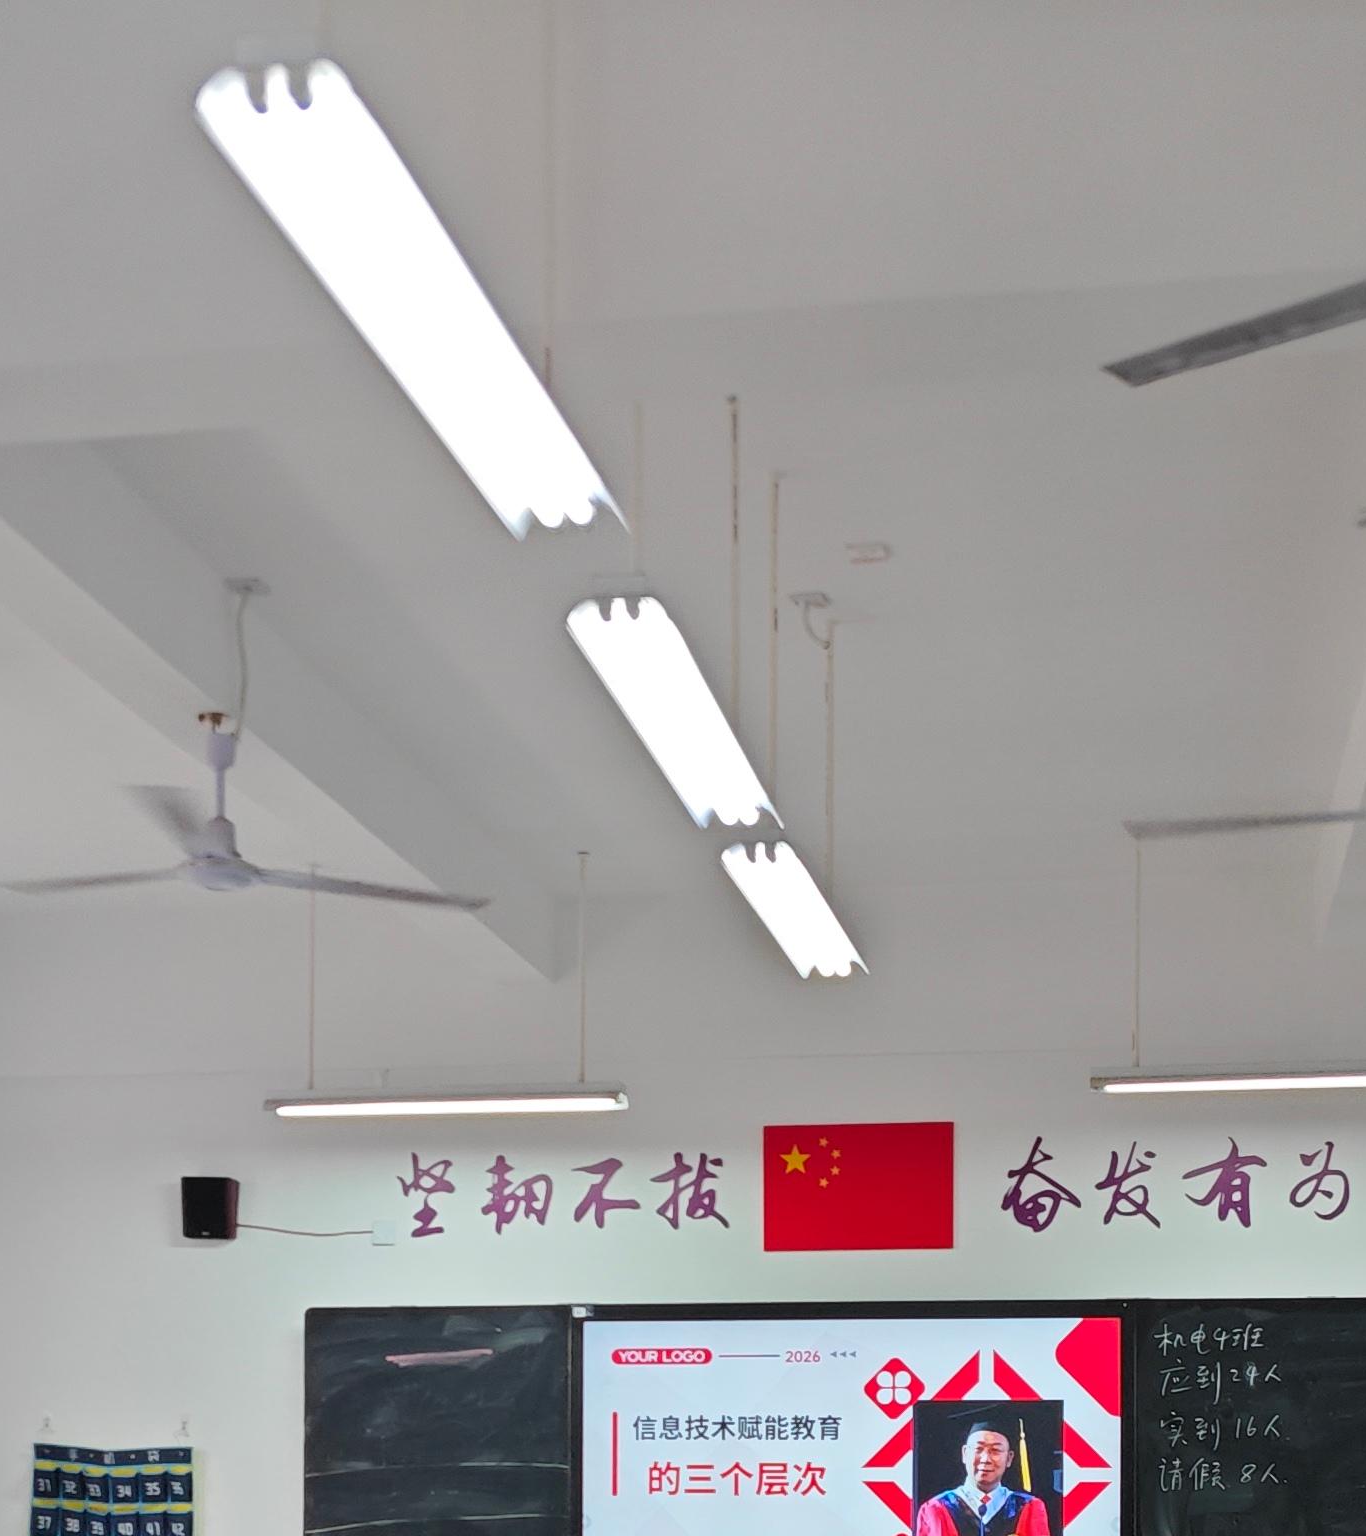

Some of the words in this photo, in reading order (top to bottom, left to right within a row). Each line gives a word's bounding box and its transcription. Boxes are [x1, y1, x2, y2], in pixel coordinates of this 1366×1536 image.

[1001, 1136, 1351, 1232] 奋发有为
[618, 1350, 658, 1362] YOUR
[662, 1350, 705, 1362] LOGO
[785, 1351, 821, 1363] 2026
[633, 1415, 843, 1440] 信息技术赋能教育
[37, 1478, 51, 1491] 31
[116, 1485, 132, 1497] 34
[145, 1482, 161, 1495] 35
[649, 1462, 826, 1496] 的三个层次
[37, 1516, 51, 1530] 37
[65, 1518, 80, 1532] 38
[117, 1523, 134, 1536] 40
[146, 1522, 161, 1535] 41
[172, 1523, 186, 1536] 42
